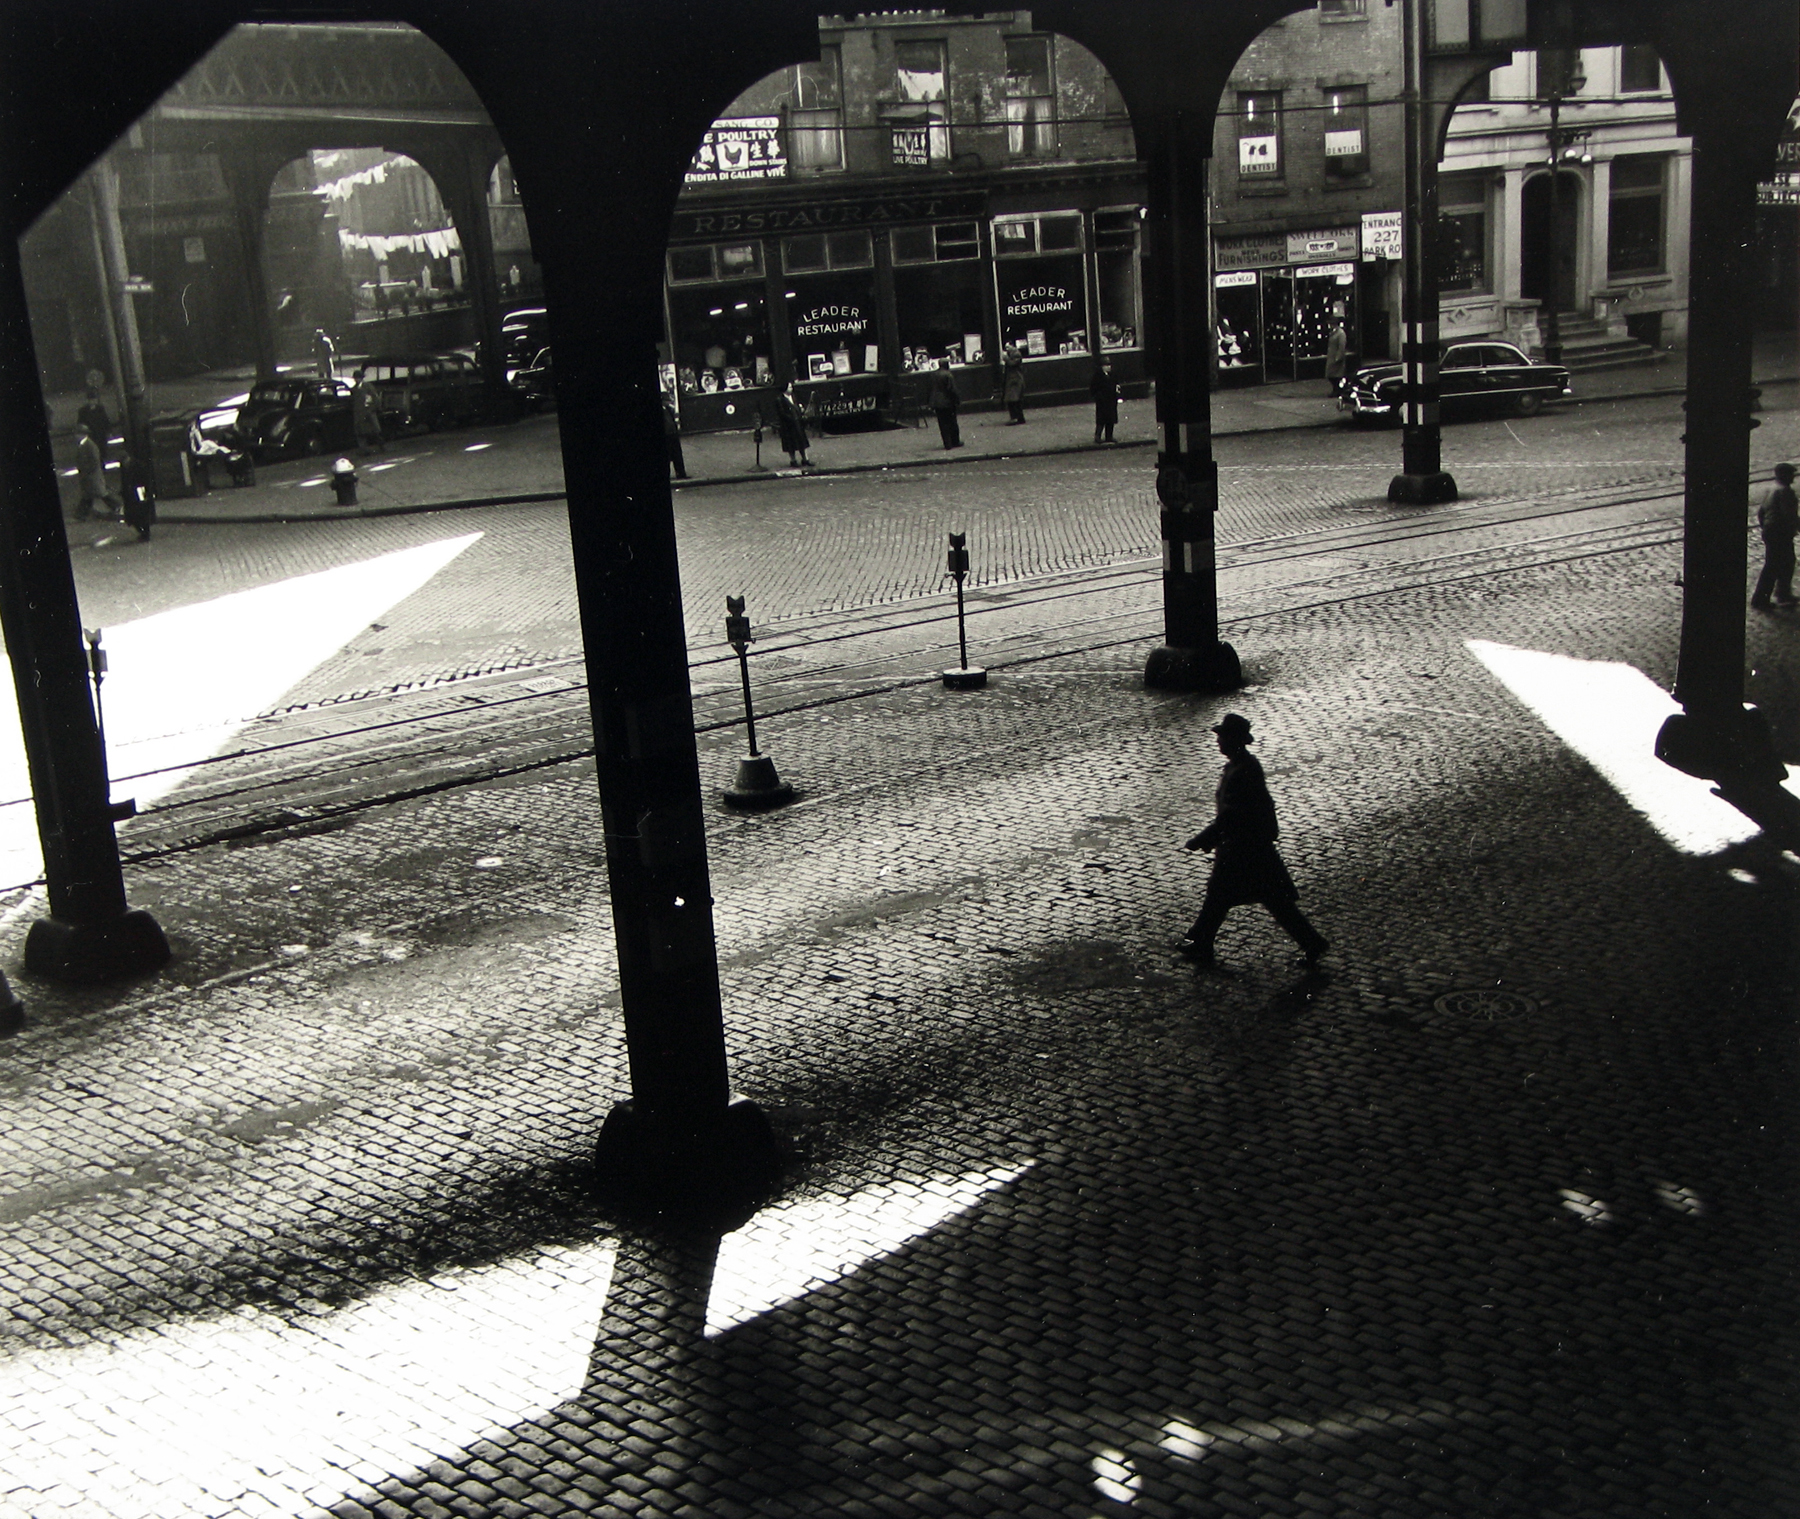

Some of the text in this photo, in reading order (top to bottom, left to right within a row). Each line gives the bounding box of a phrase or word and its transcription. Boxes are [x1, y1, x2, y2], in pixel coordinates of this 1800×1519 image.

[718, 129, 778, 142] POULTRY
[1326, 145, 1360, 155] DENTIST
[684, 164, 786, 183] ENDITA DI GALLINE VIVE
[1241, 163, 1276, 173] DENTIST
[694, 200, 942, 234] RESTAURANT
[1363, 217, 1402, 229] ENTRANC
[1374, 230, 1399, 242] 227
[1218, 249, 1285, 266] FURNISHINGS
[1364, 244, 1401, 257] PARK RO
[1012, 286, 1066, 303] LEADER
[803, 305, 860, 323] LEADER
[1007, 300, 1073, 316] RESTAURANT
[797, 319, 868, 336] RESTAURANT
